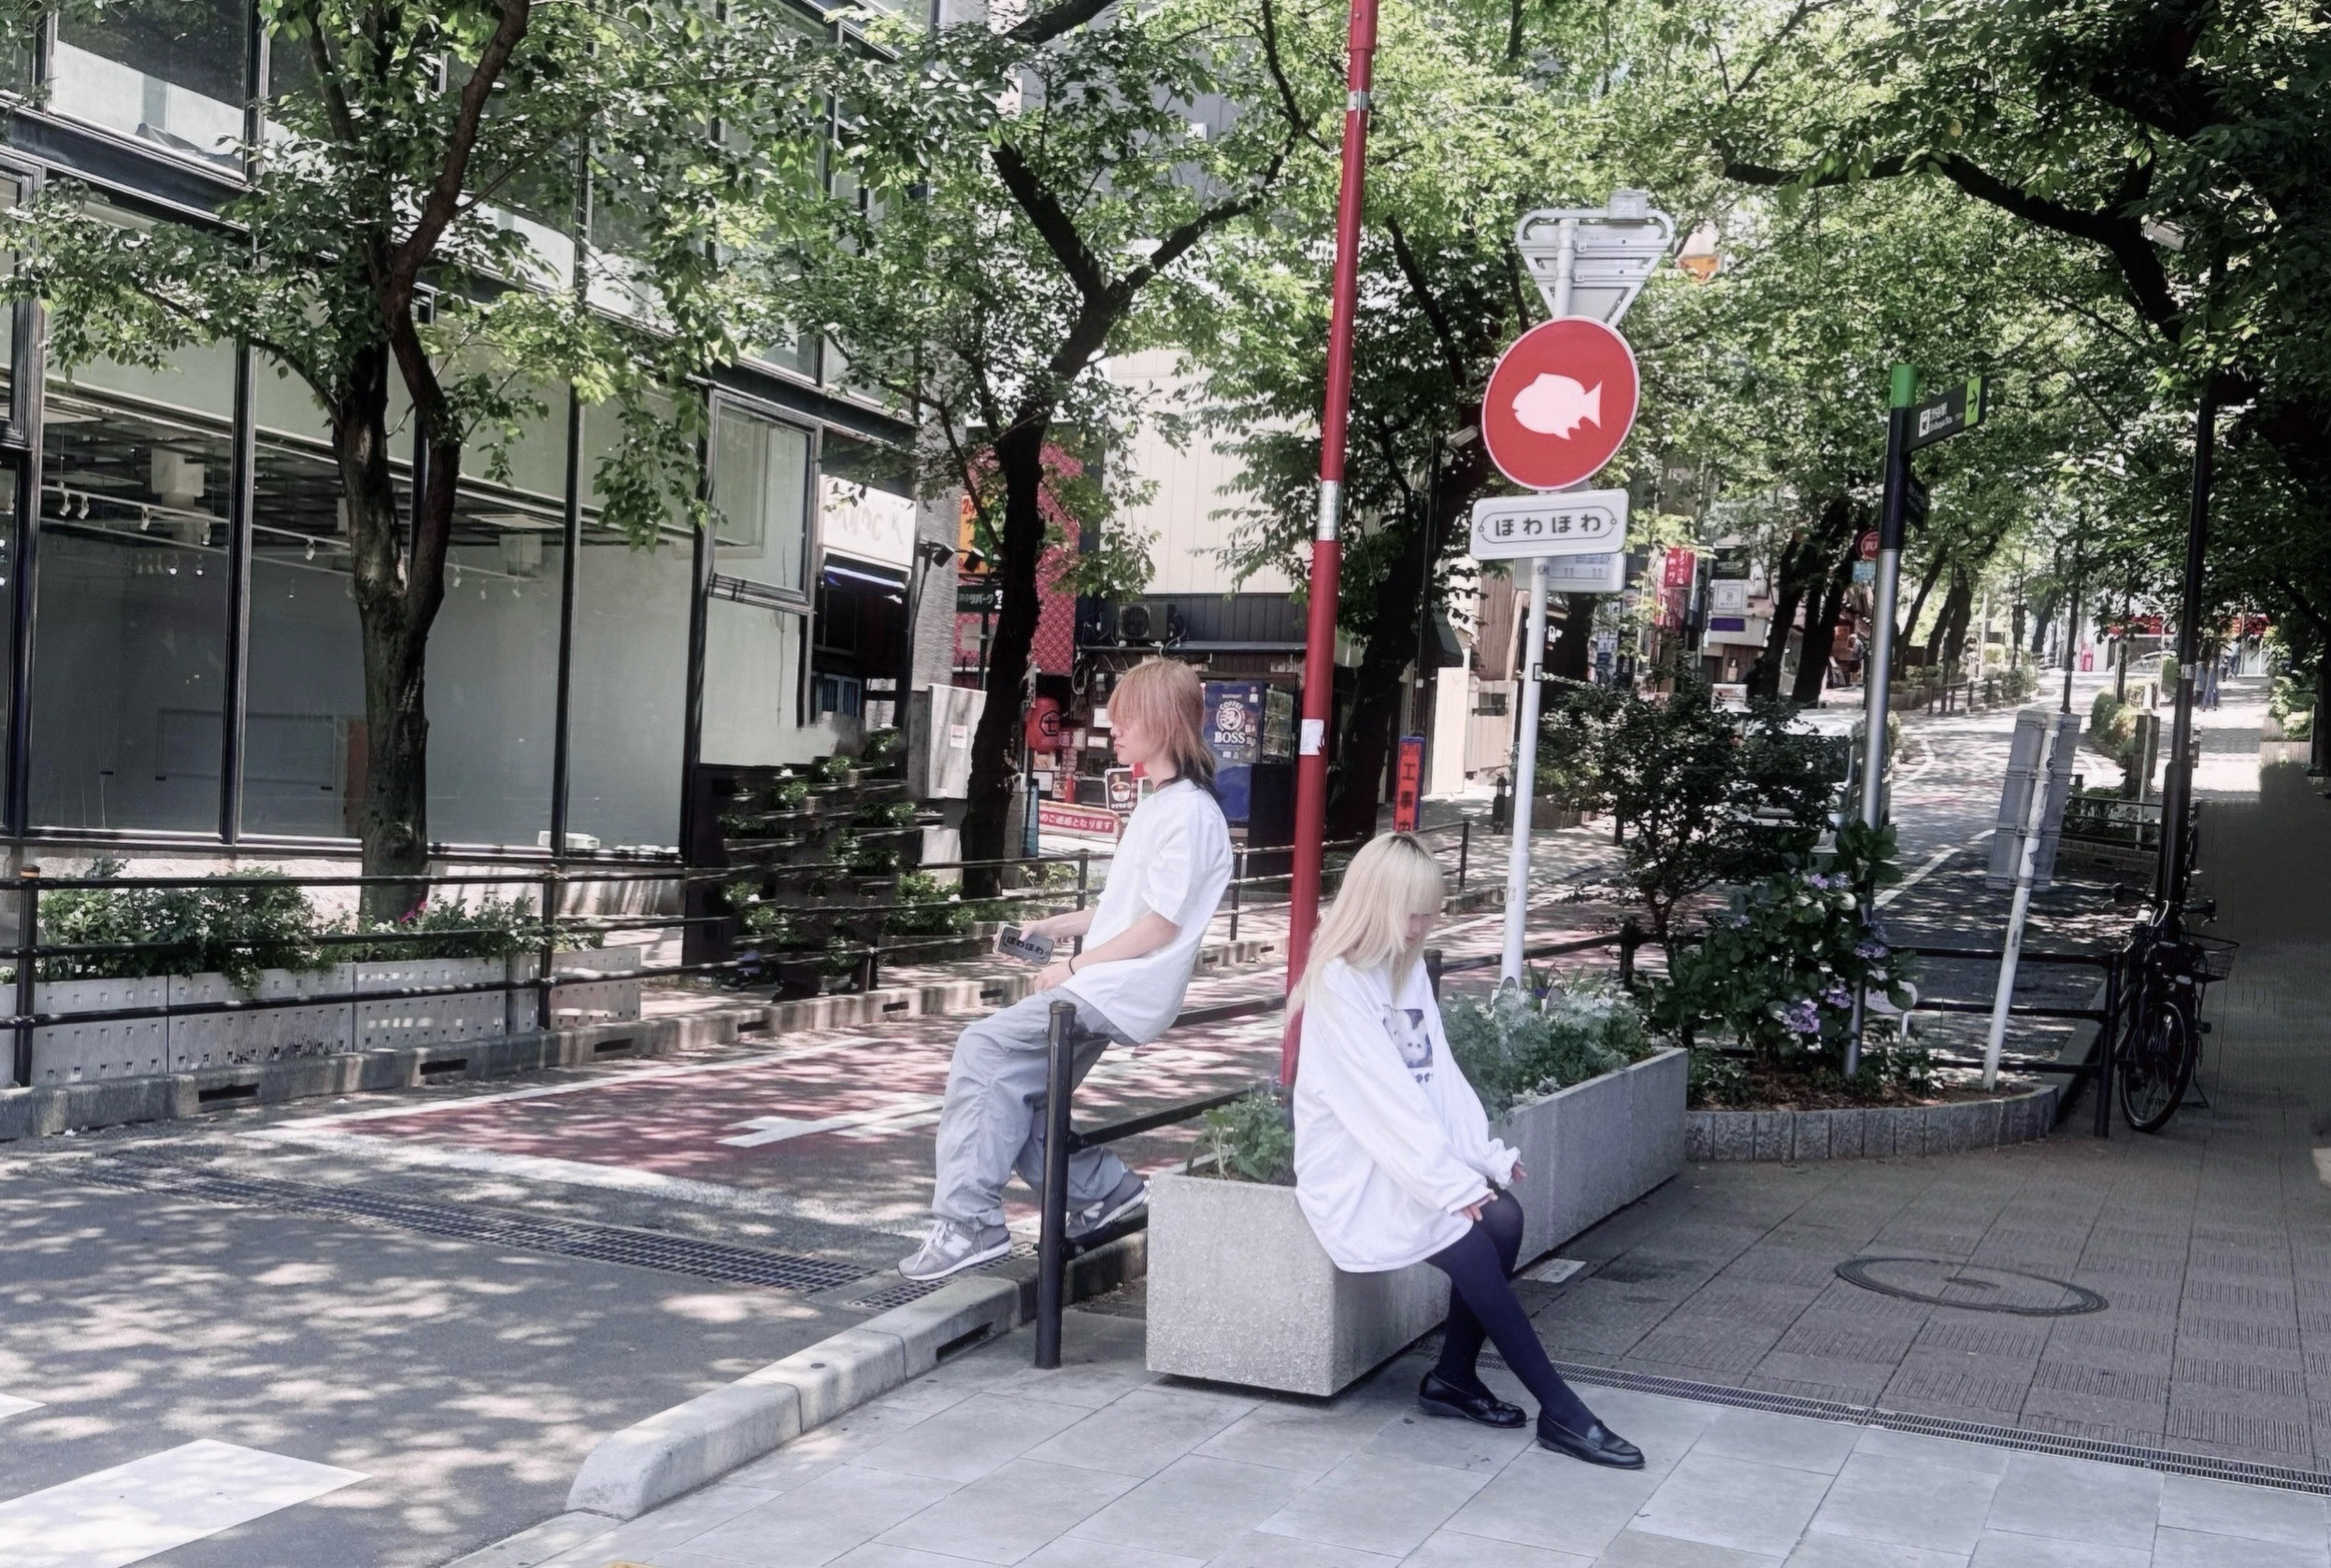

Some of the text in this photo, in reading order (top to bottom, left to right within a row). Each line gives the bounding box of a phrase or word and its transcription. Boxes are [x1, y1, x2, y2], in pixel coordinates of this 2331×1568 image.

[1495, 514, 1601, 537] ほわほわ
[1219, 701, 1244, 711] COFFEE
[1214, 731, 1246, 744] BOSS
[1007, 935, 1045, 955] ほわほわ
